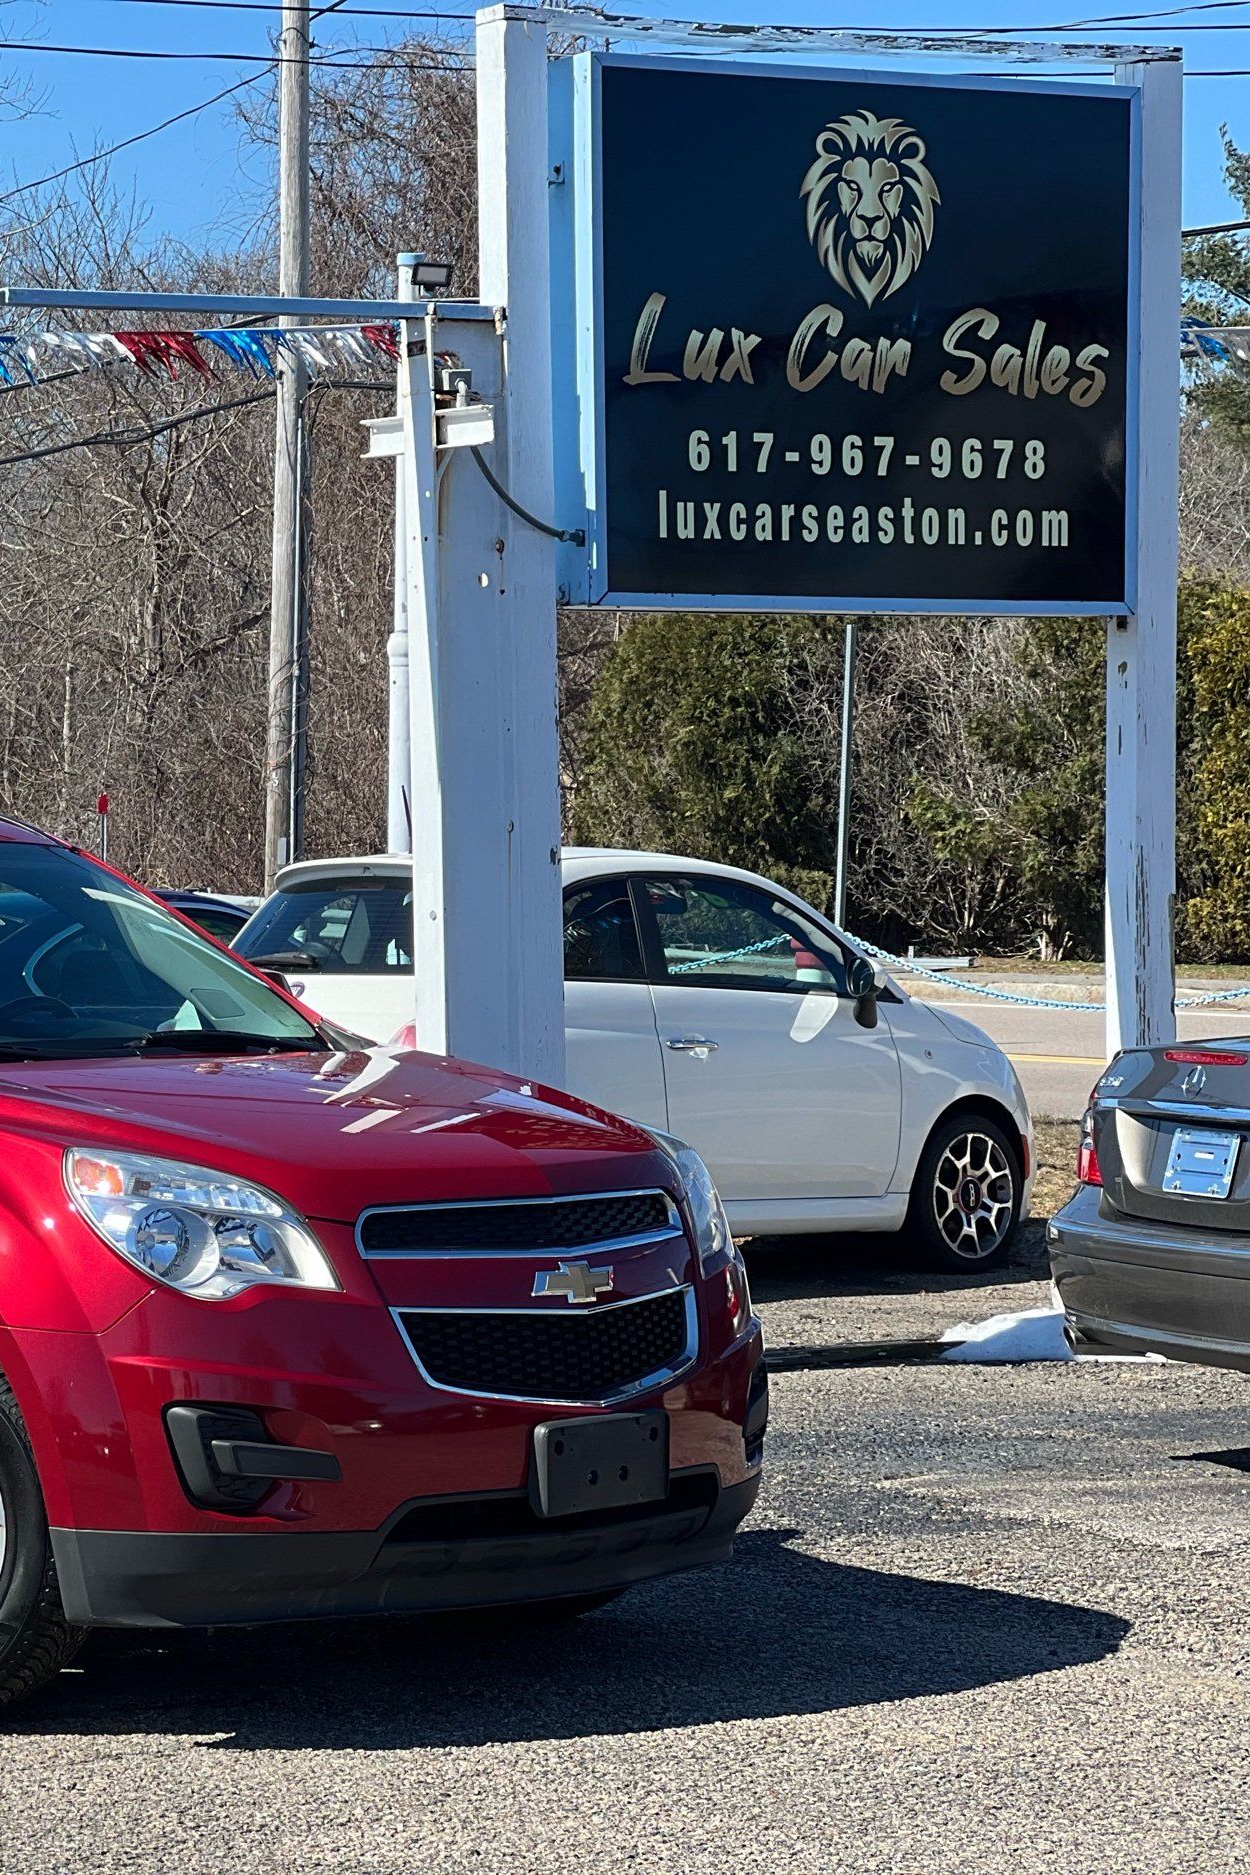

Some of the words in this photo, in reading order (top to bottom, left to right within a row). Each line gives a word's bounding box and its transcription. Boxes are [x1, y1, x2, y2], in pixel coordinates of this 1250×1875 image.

[622, 292, 763, 386] Lux
[786, 303, 912, 394] Car
[939, 307, 1110, 408] Sales
[688, 429, 1047, 480] 617-967-9678
[658, 489, 1070, 547] luxcarseaston.com
